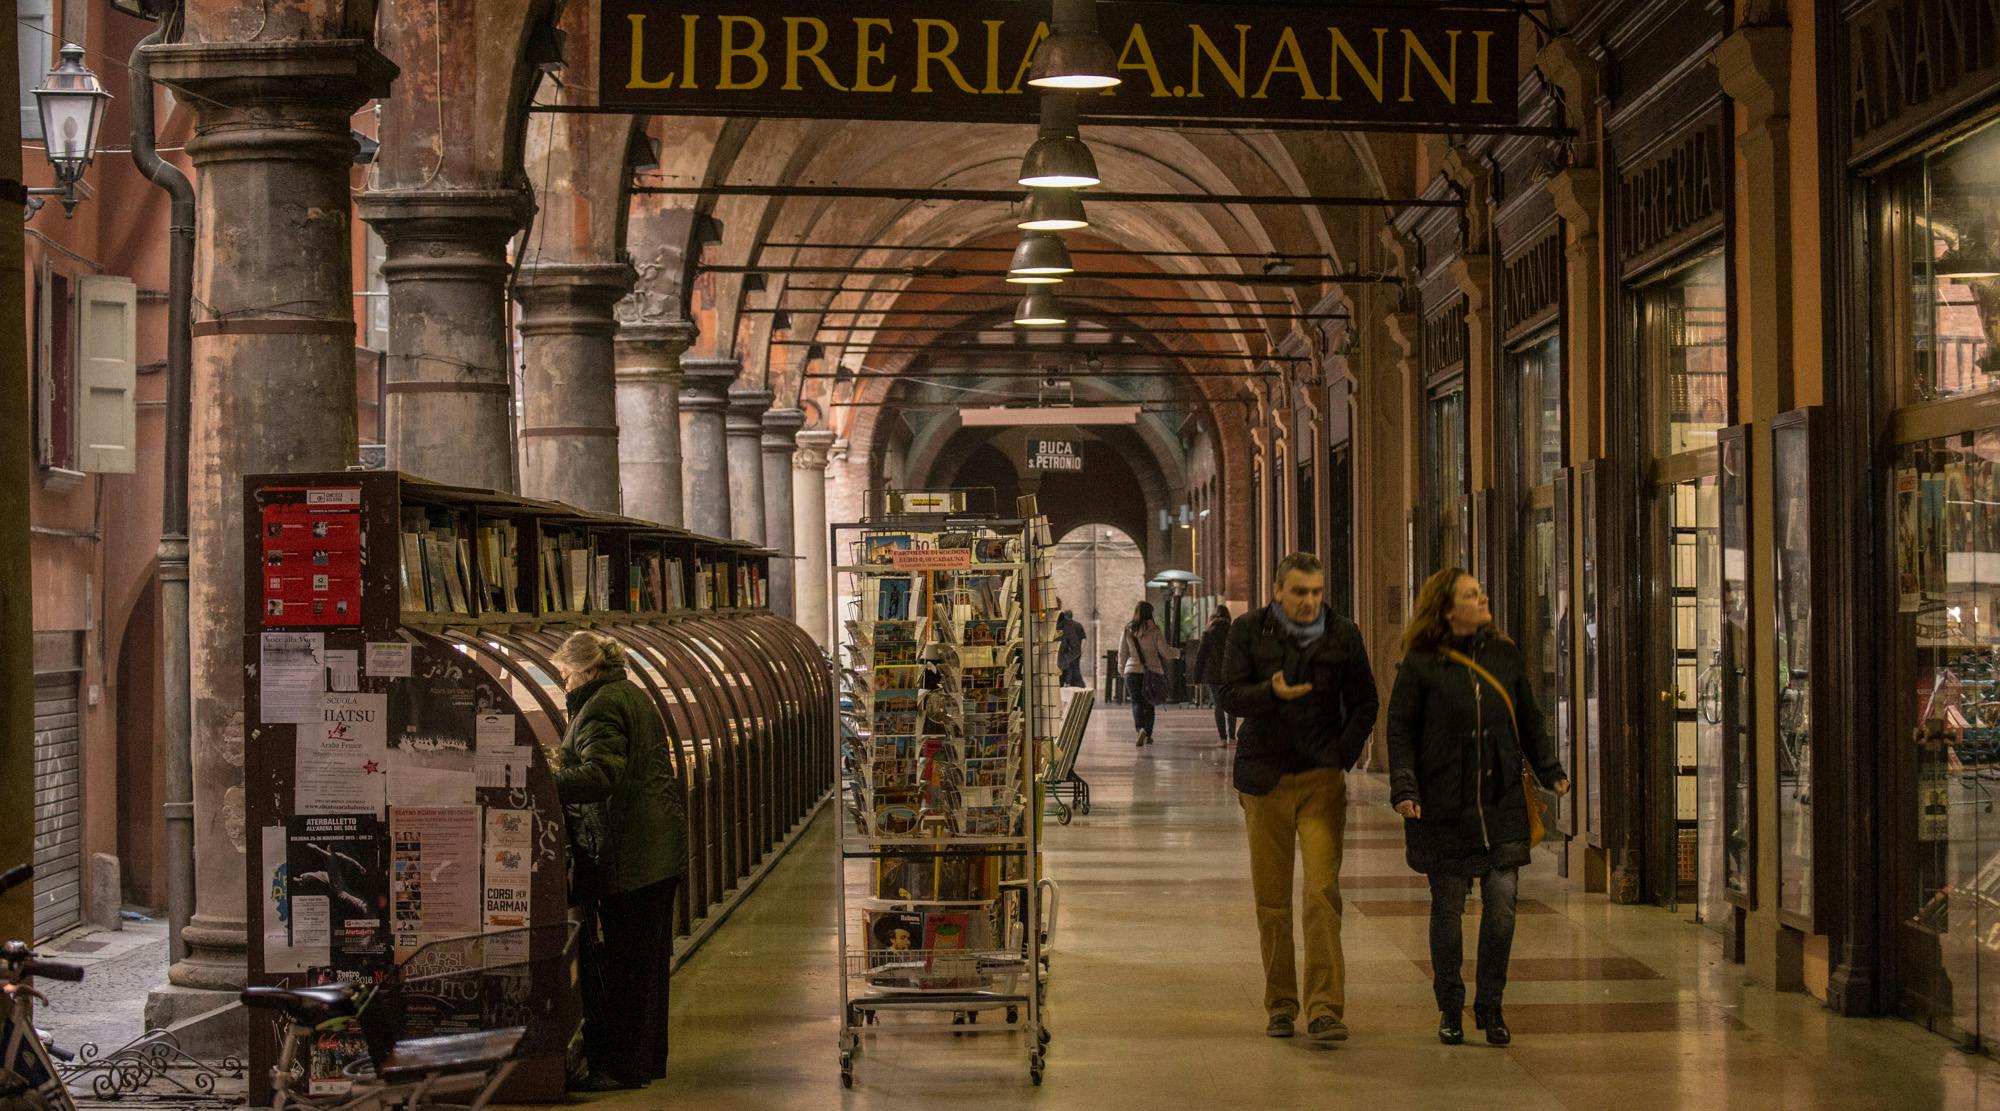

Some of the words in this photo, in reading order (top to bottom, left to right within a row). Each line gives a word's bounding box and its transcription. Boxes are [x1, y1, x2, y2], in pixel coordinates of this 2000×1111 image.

[1099, 23, 1495, 104] A.NANNI
[1039, 440, 1072, 454] BUCA
[326, 697, 357, 705] SCUOLA
[306, 818, 357, 826] ATERBALLETTO
[487, 888, 514, 899] CORSI
[515, 890, 527, 898] PER
[487, 900, 528, 912] BARMAN
